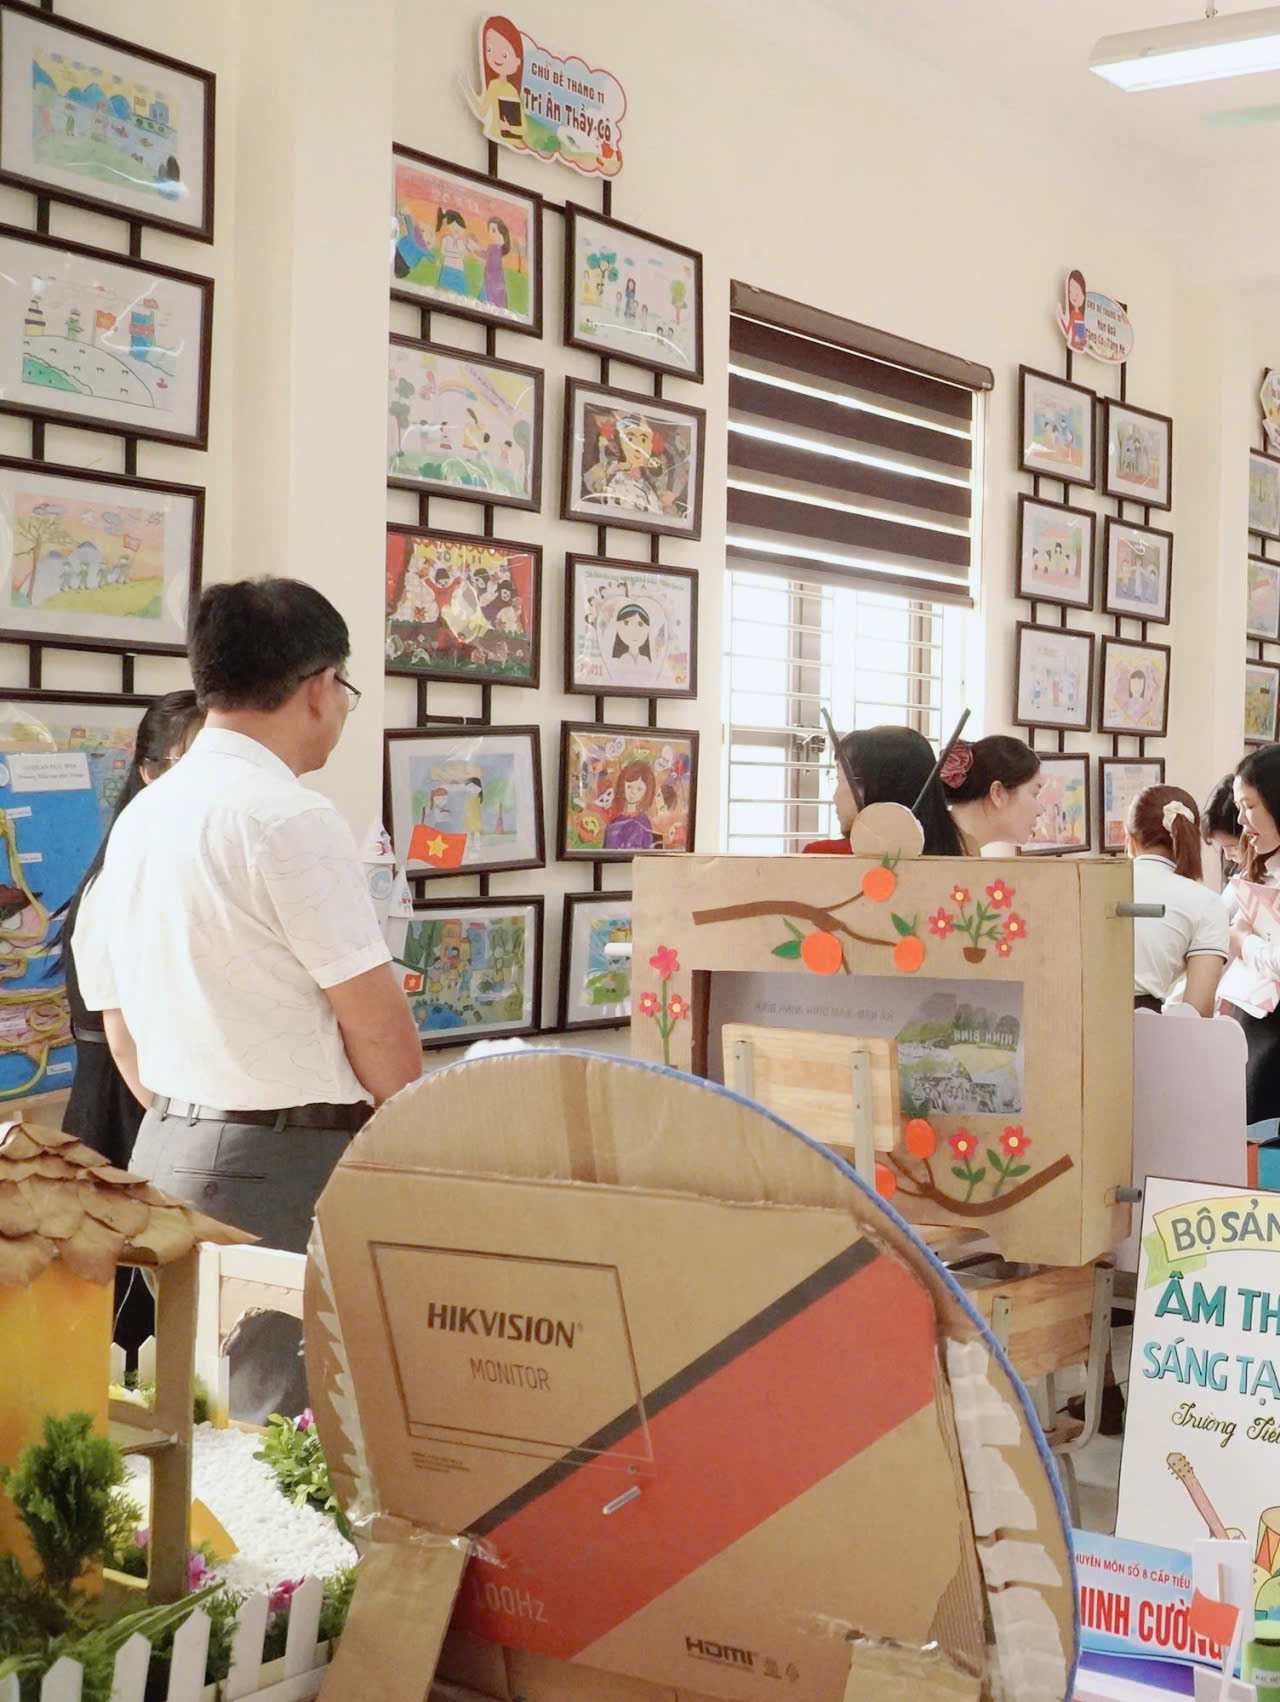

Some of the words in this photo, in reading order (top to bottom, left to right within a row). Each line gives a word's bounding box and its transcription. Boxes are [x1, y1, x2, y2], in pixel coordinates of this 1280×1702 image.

[531, 62, 551, 80] CHỦ
[567, 77, 595, 100] THÁNG
[524, 87, 542, 115] Tri
[546, 91, 561, 122] Ân
[565, 103, 594, 137] Thầy
[597, 117, 611, 142] Cô
[1171, 1208, 1216, 1251] BỘ
[1154, 1271, 1228, 1327] ÂM
[427, 1302, 576, 1349] HIKVISION
[470, 1357, 551, 1392] MONITOR
[1141, 1337, 1229, 1391] SÁNG
[1171, 1401, 1238, 1448] Trường
[1103, 1557, 1125, 1574] MÔN
[1128, 1562, 1140, 1577] SỐ
[1142, 1568, 1149, 1578] 8
[1150, 1568, 1170, 1584] CẤP
[1172, 1571, 1192, 1589] TIỂU
[685, 1636, 754, 1666] HDMI
